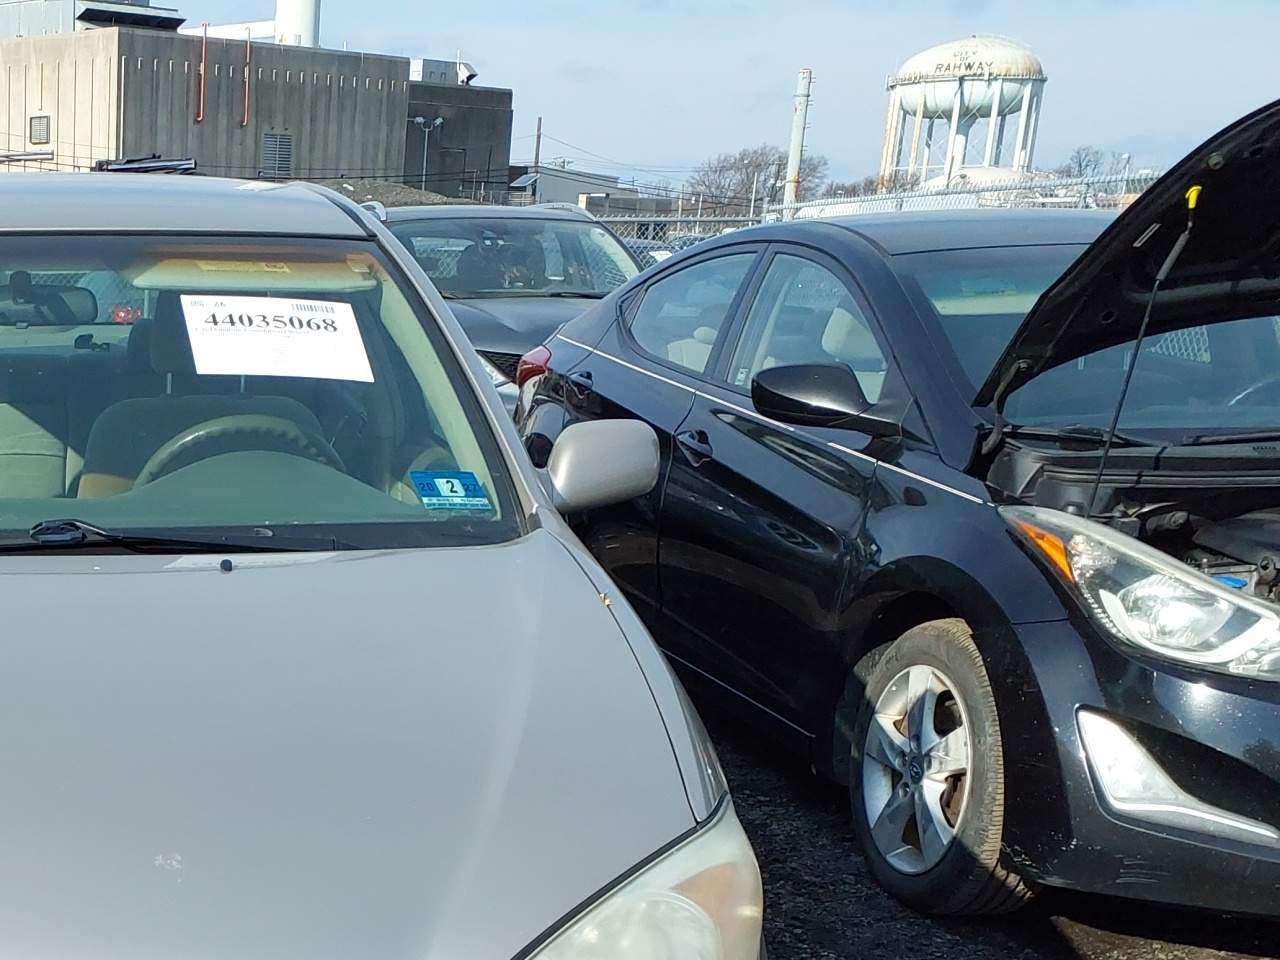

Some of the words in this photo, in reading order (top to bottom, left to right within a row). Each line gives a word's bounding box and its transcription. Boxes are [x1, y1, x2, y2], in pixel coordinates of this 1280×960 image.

[934, 61, 994, 73] RAHWAY
[204, 313, 338, 332] 44035068
[445, 479, 459, 494] 2
